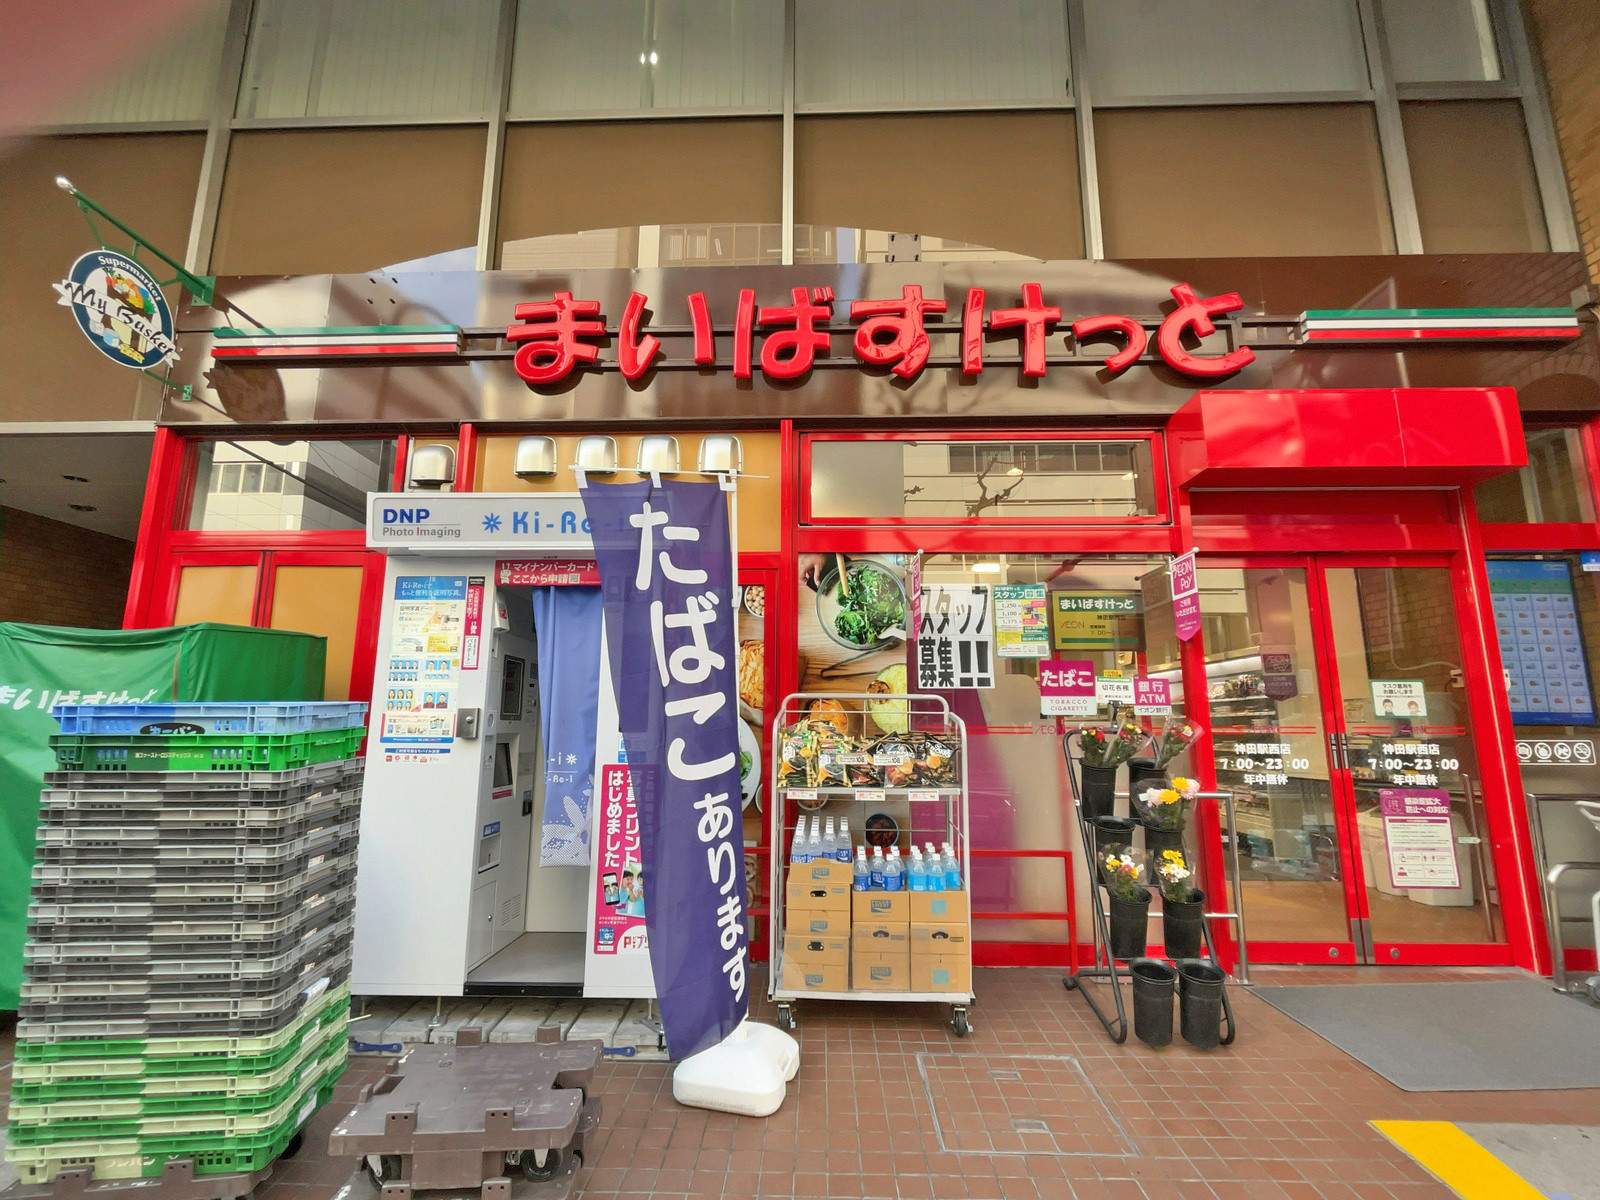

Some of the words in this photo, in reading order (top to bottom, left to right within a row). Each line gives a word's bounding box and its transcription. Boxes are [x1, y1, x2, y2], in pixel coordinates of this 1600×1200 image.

[98, 256, 161, 301] Supermarket
[65, 282, 107, 314] My
[117, 305, 174, 356] Basket
[506, 283, 1256, 381] まいばすけっと
[383, 509, 430, 523] DNP
[382, 527, 414, 536] Photo
[416, 527, 461, 538] Imaging
[513, 562, 595, 572] マイナンバーカード
[513, 574, 568, 584] ここから申請
[1060, 599, 1134, 610] まいばすけっと
[1041, 669, 1094, 687] たばこ
[1138, 681, 1164, 692] 銀行
[1139, 693, 1166, 704] ATM
[1234, 743, 1291, 755] 神田駅西店
[1382, 743, 1440, 755] 神田駅西店
[1244, 773, 1288, 785] 年中無休
[1393, 773, 1438, 786] 年中無休
[605, 770, 624, 867] はじめました
